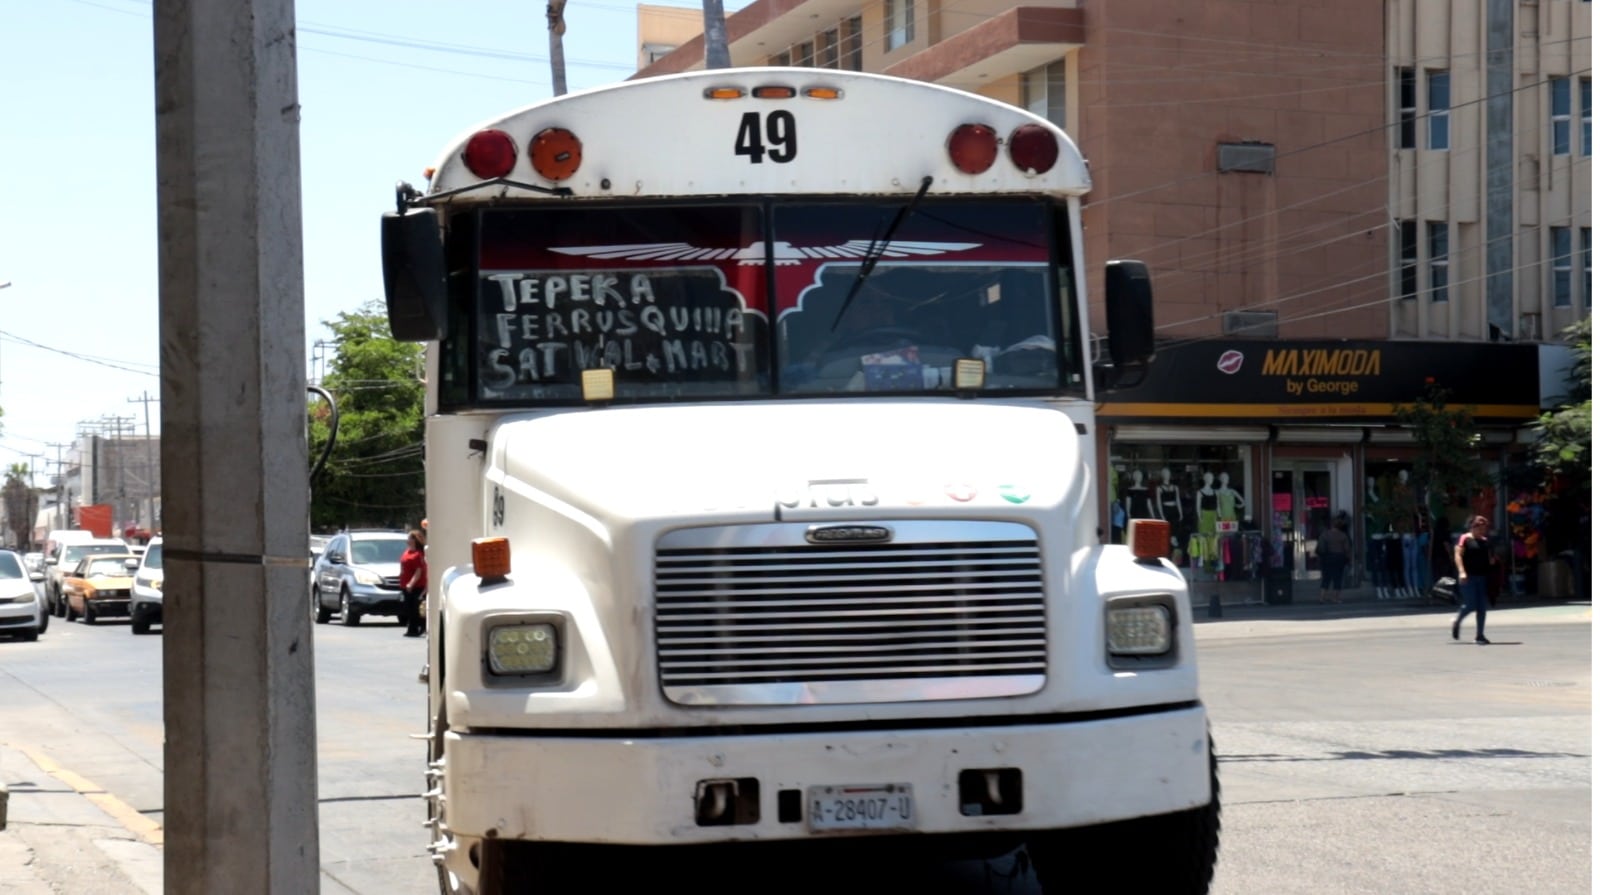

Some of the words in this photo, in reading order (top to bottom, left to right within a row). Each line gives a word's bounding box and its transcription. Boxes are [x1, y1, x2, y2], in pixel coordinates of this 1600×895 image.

[735, 109, 797, 164] 49
[488, 273, 655, 312] TEPEKA
[1261, 349, 1381, 376] MAXIMODA
[1286, 378, 1304, 396] by
[1307, 377, 1359, 395] George
